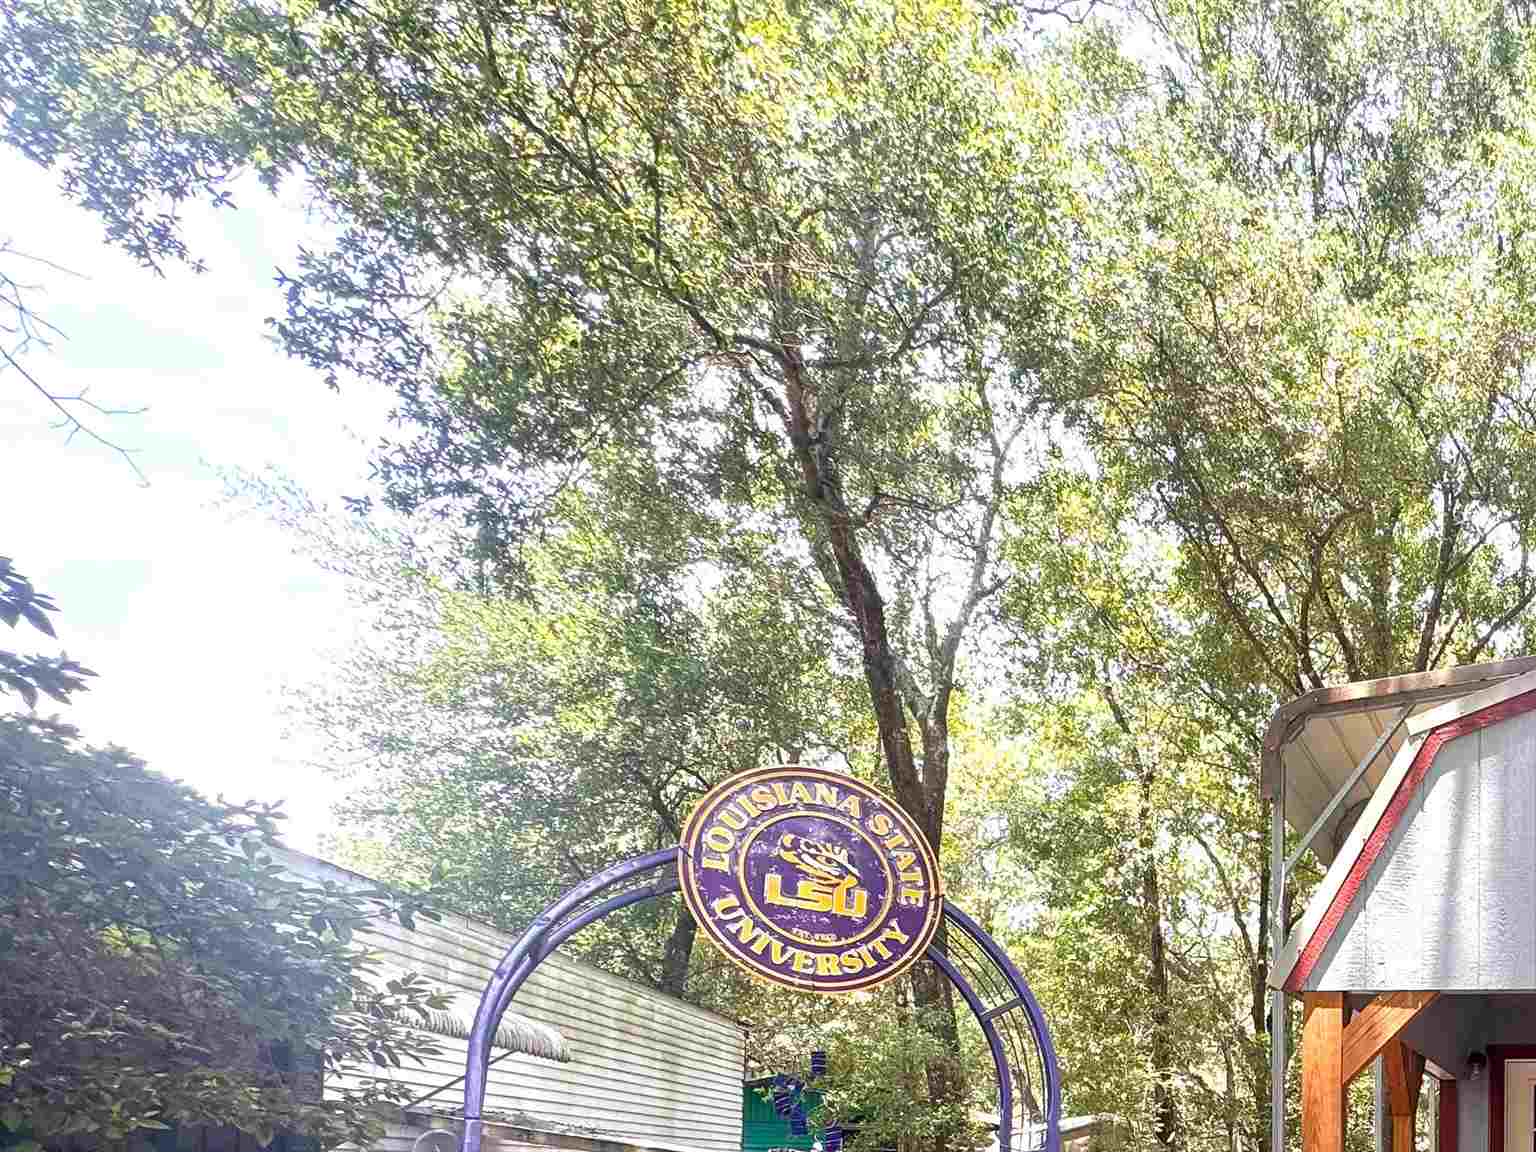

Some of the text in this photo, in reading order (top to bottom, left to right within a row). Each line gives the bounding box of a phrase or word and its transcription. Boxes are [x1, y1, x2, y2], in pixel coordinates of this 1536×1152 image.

[702, 783, 925, 908] LOUISIANA STATE
[764, 872, 868, 918] LSU
[711, 896, 909, 976] UNIVERSITY
